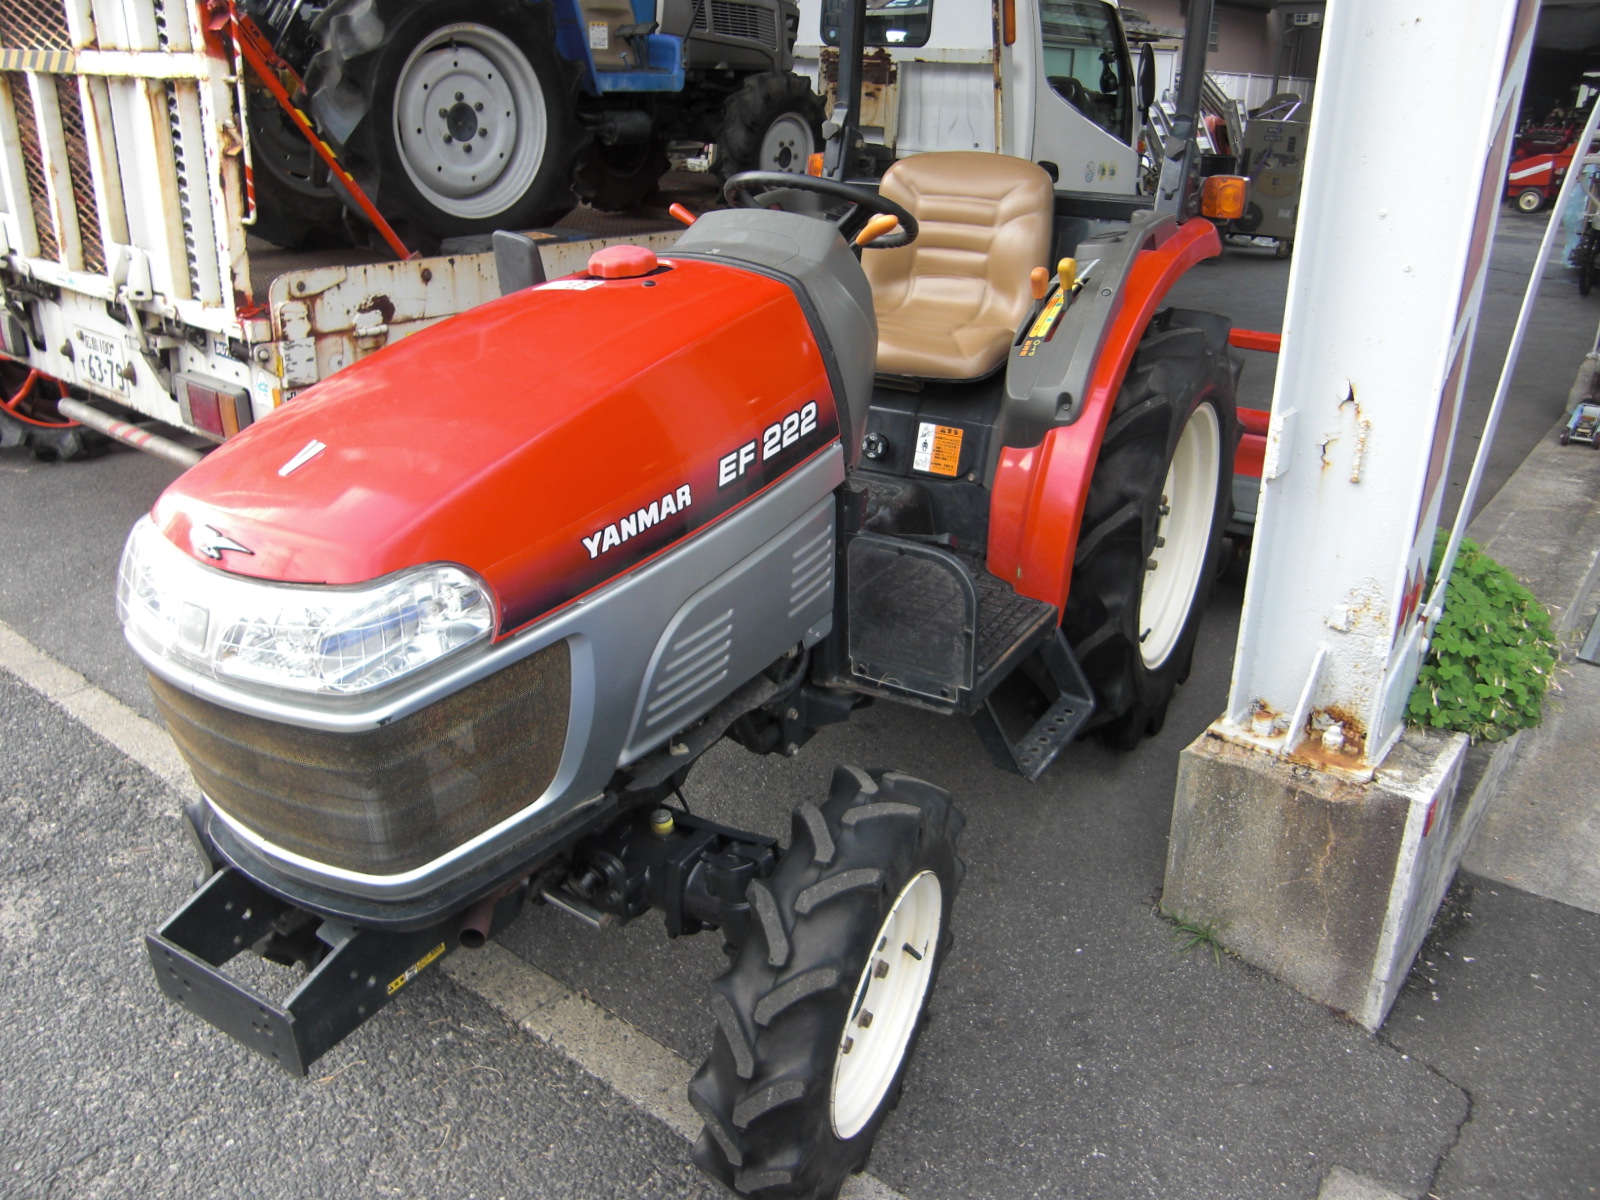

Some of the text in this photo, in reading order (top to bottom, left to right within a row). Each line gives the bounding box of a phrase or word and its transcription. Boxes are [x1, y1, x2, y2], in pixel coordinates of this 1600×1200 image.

[88, 354, 125, 391] 63-79
[581, 401, 818, 560] YANMAR EF 222
